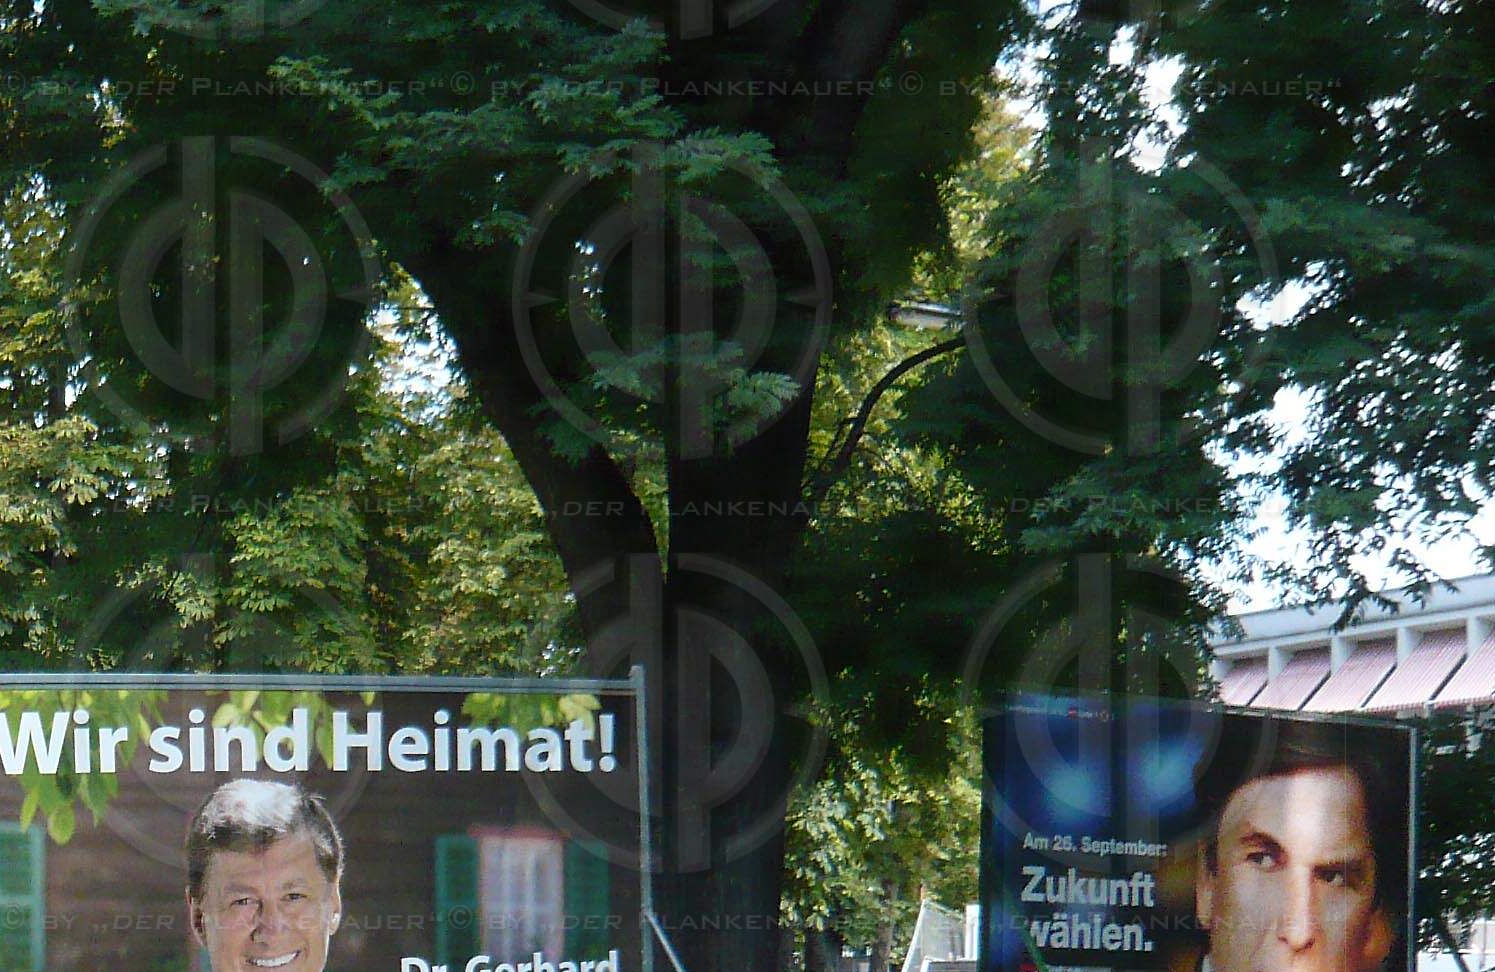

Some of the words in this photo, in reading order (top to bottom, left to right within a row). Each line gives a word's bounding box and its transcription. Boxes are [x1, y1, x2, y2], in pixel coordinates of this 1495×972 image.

[148, 707, 310, 773] sind
[332, 709, 617, 773] Heimat!
[1023, 831, 1049, 850] Am
[1081, 835, 1169, 857] September:
[1020, 865, 1156, 908] Zukunft
[1024, 911, 1154, 953] wählen.
